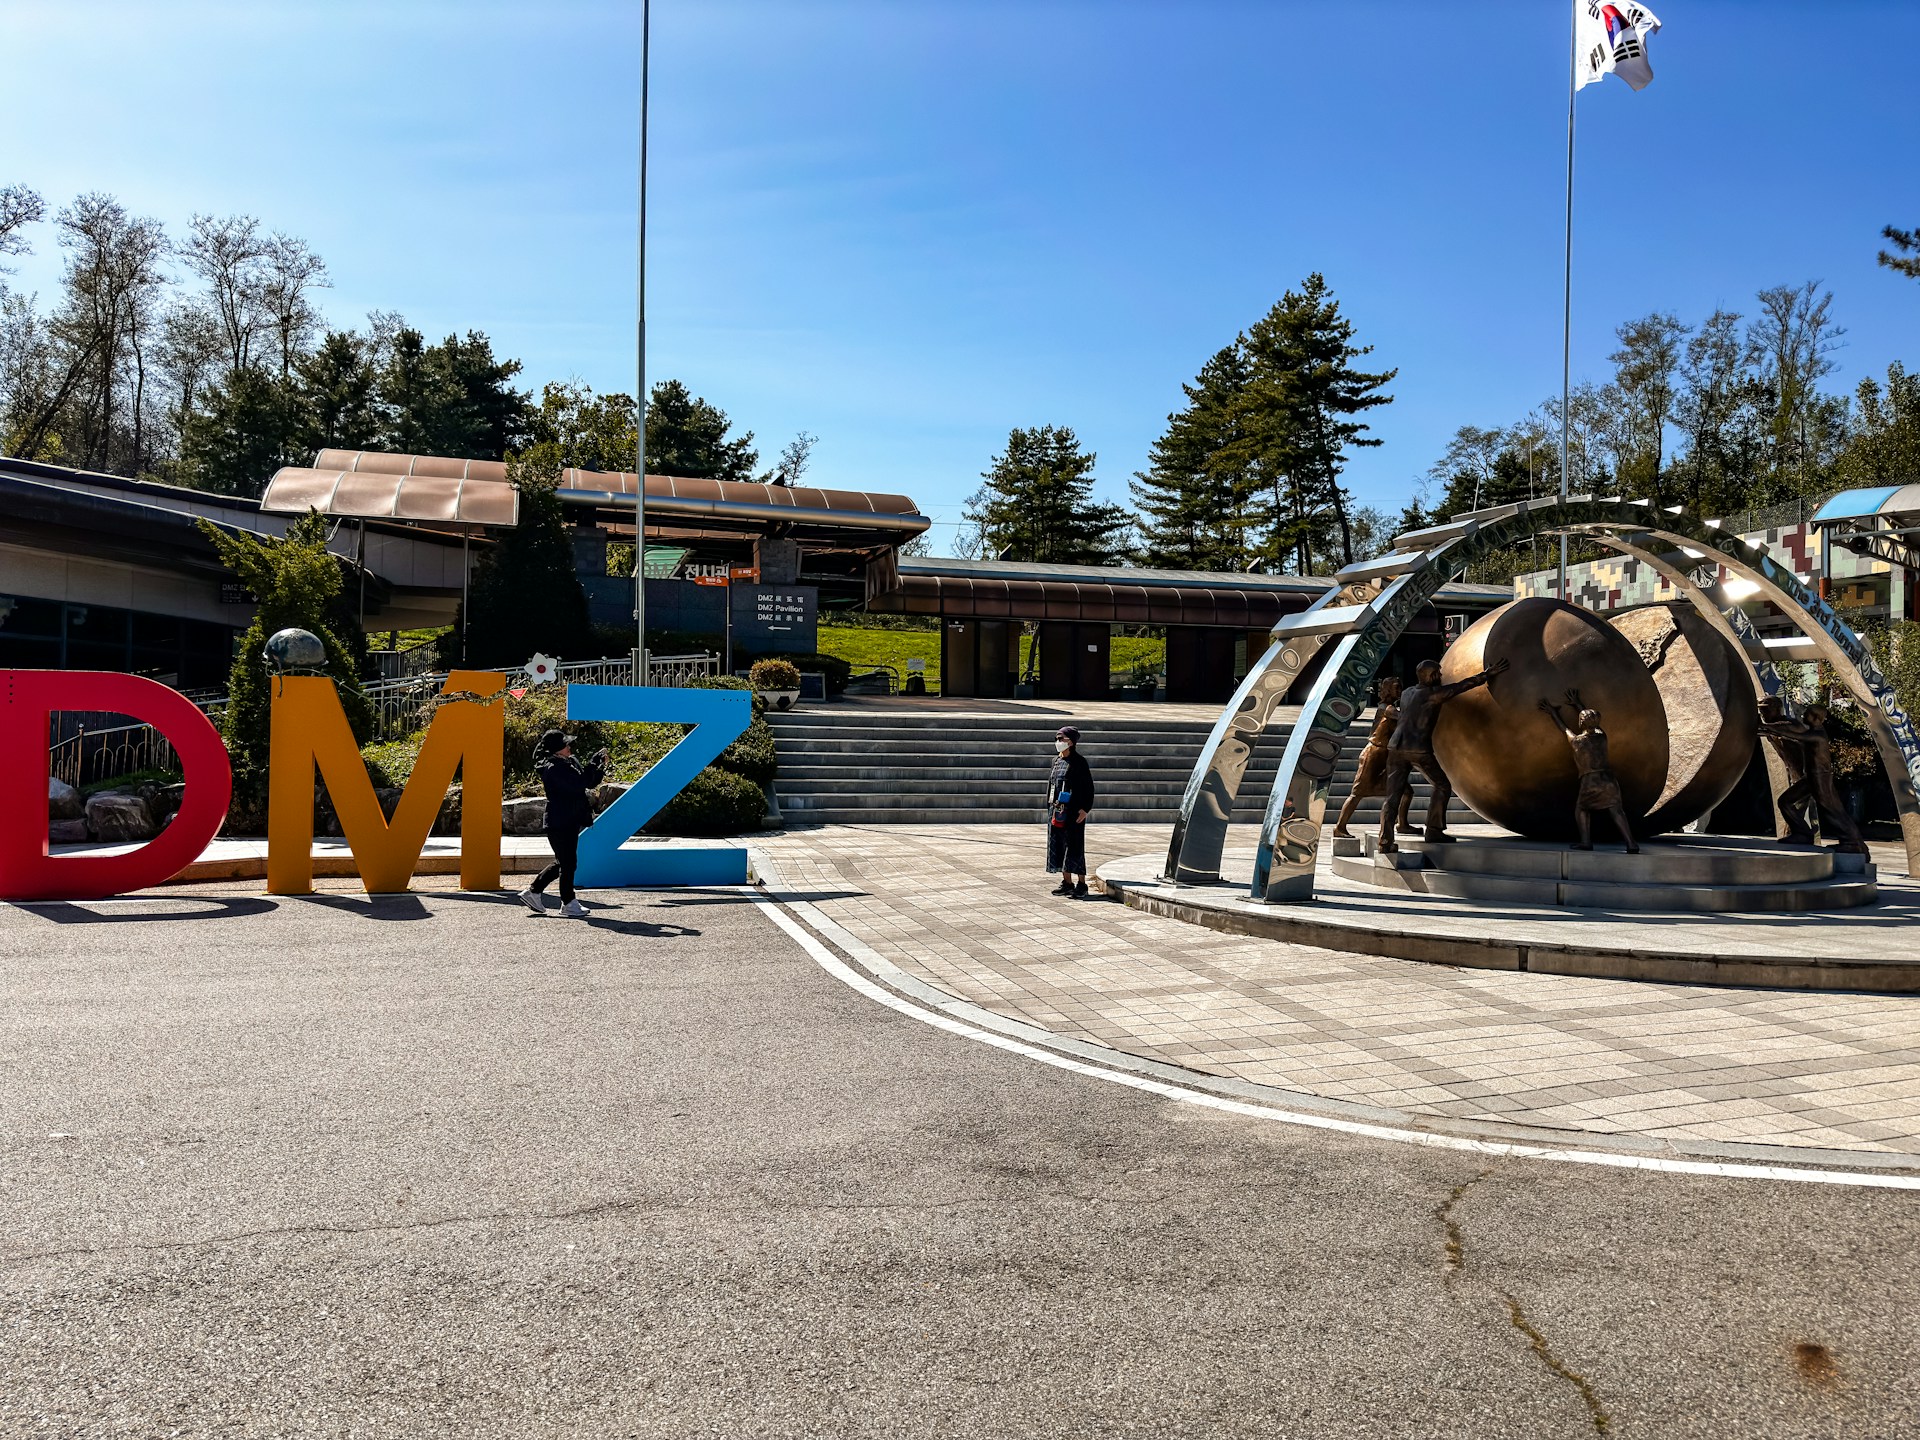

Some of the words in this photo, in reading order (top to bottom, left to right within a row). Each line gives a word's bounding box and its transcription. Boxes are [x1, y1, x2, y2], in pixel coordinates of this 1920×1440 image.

[757, 594, 774, 602] DMZ
[1788, 579, 1809, 605] The
[1810, 597, 1832, 626] 3rd
[775, 604, 804, 613] Pavilion
[757, 613, 774, 621] DMZ
[0, 669, 752, 901] DMZ
